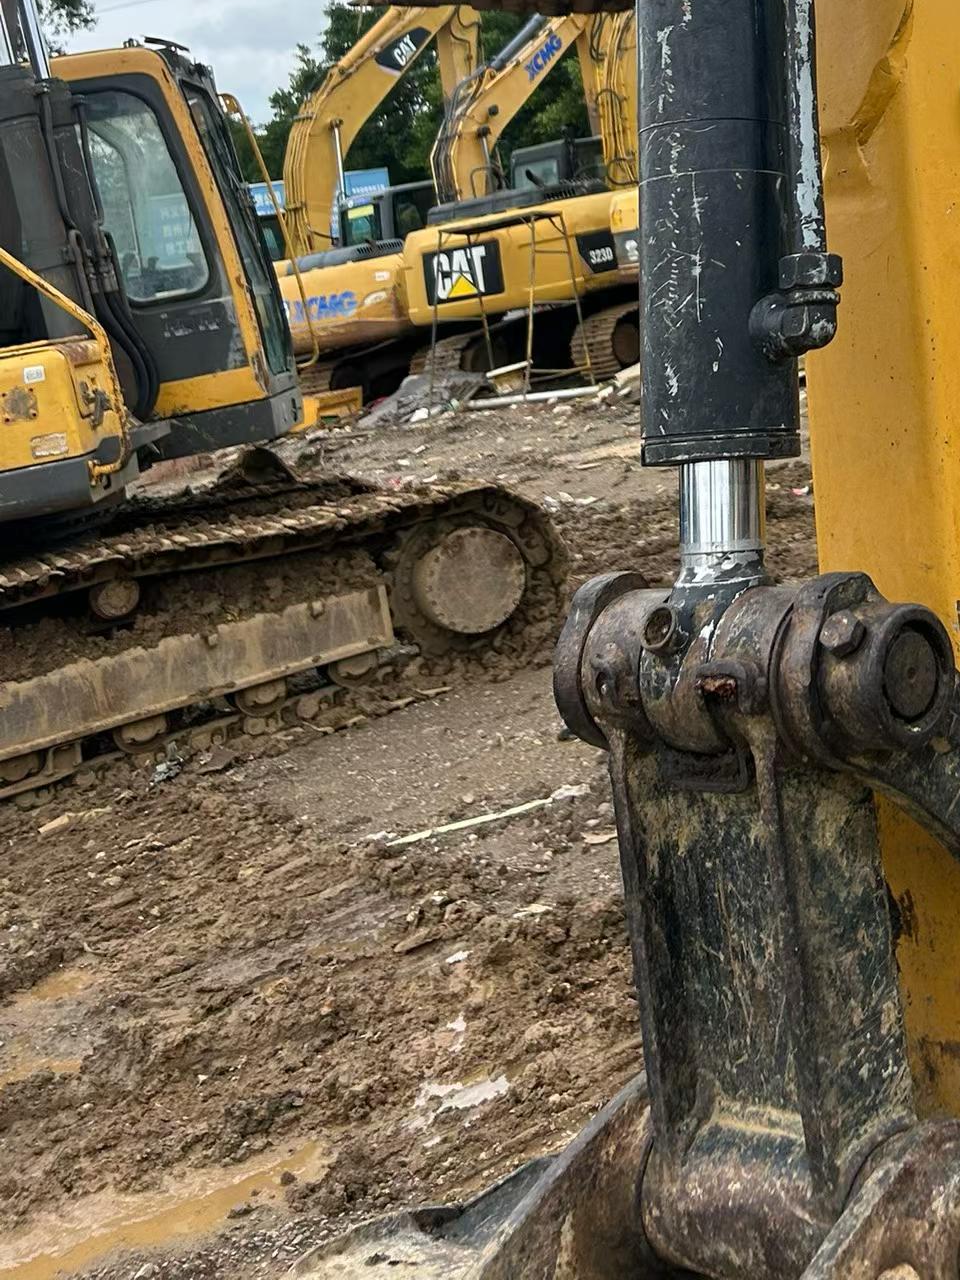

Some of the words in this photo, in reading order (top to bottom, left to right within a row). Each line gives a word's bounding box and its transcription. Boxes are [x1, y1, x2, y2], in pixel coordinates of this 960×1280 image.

[393, 34, 417, 67] CAT
[524, 34, 563, 81] XCMG
[432, 245, 487, 300] CAT
[589, 246, 614, 264] 323D
